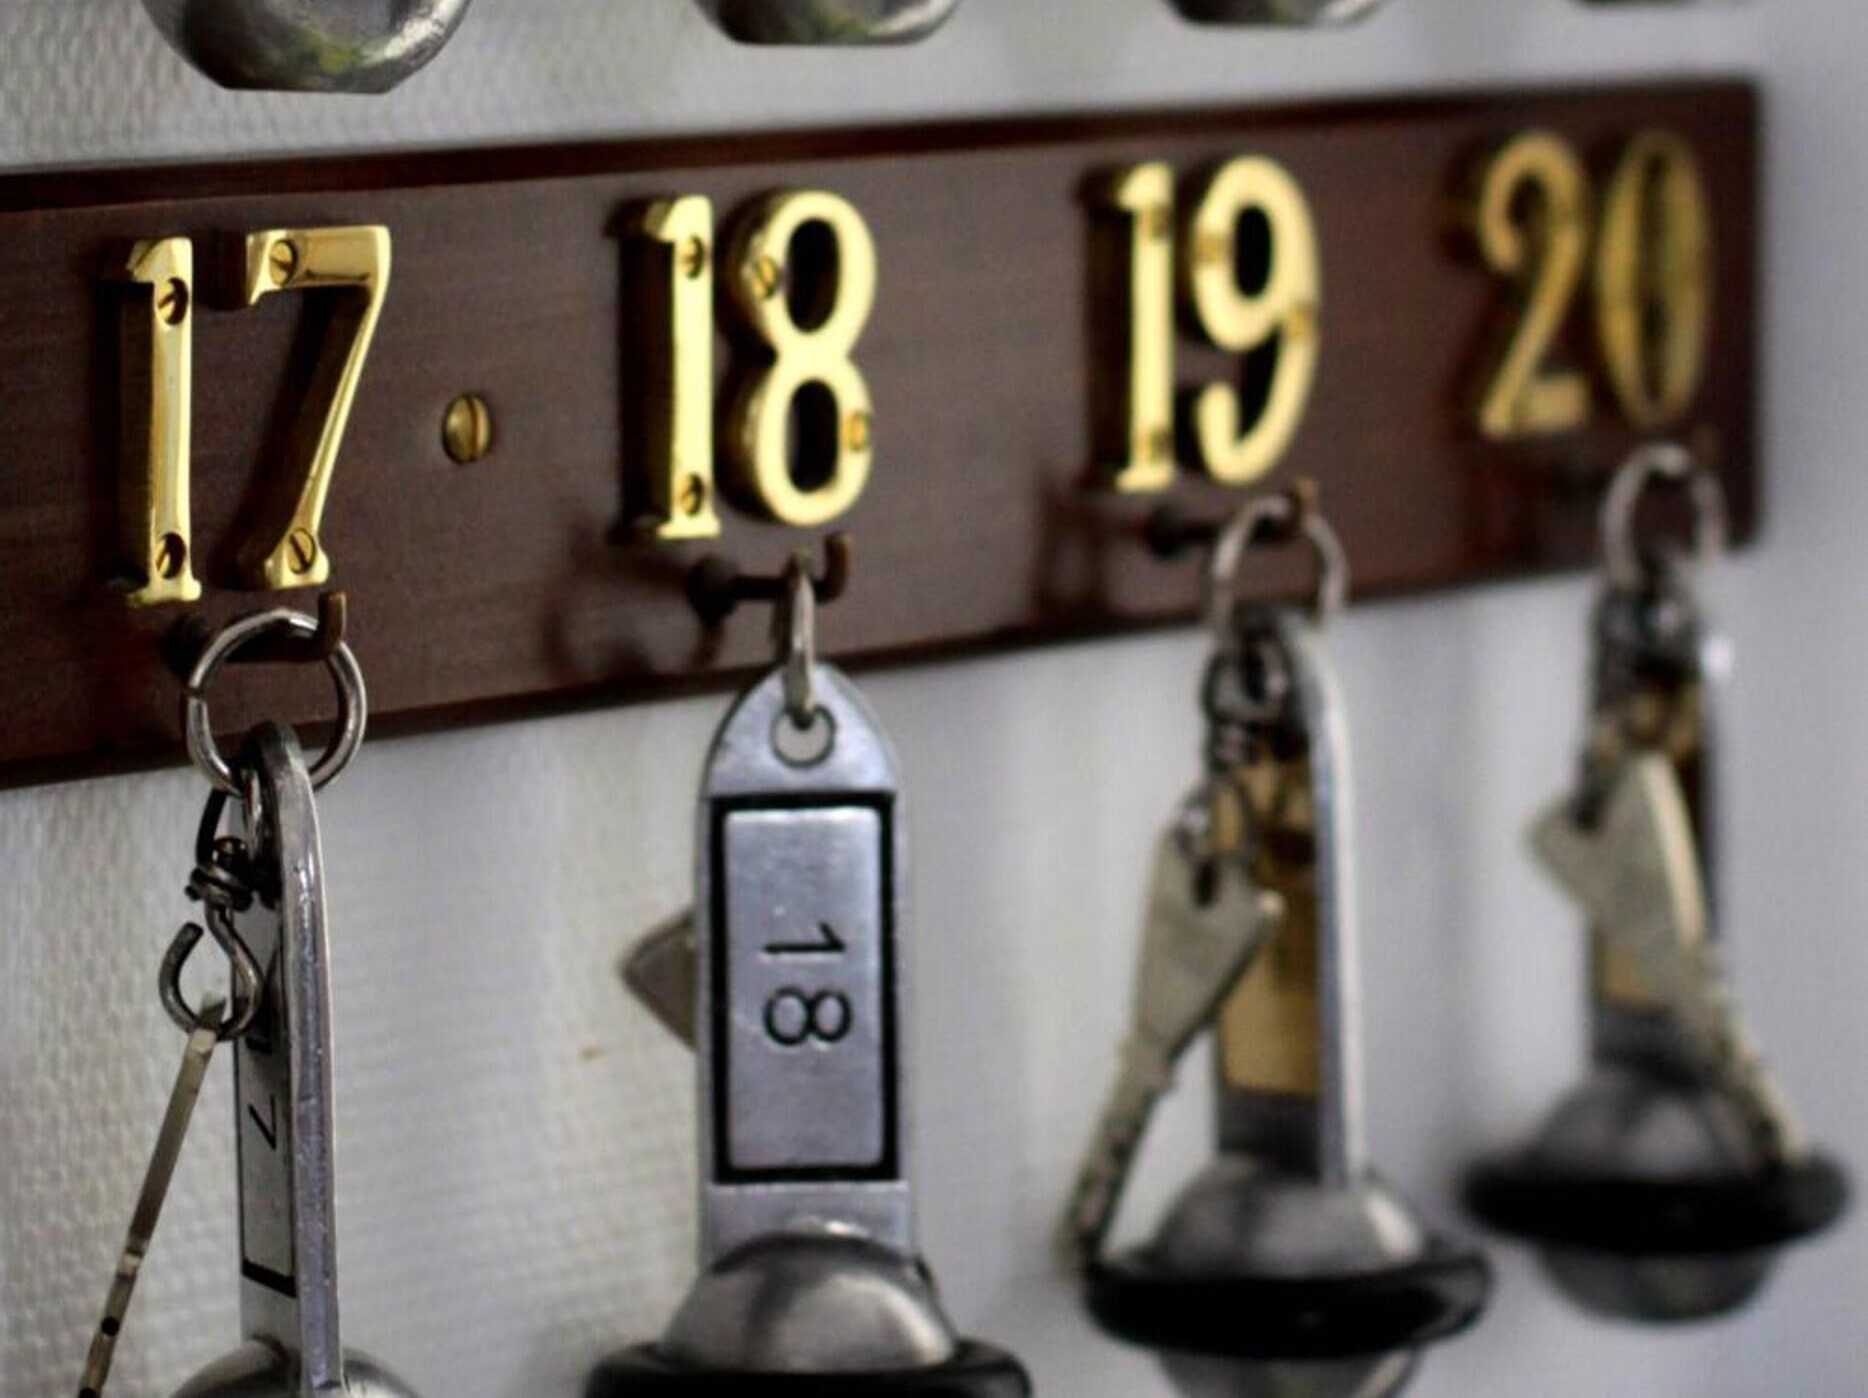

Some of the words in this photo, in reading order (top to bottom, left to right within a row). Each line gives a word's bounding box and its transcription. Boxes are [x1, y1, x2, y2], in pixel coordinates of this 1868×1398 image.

[127, 225, 392, 606] 17
[640, 191, 876, 540] 18
[1115, 155, 1318, 492] 19
[1480, 130, 1707, 437] 20
[763, 922, 853, 1046] 18
